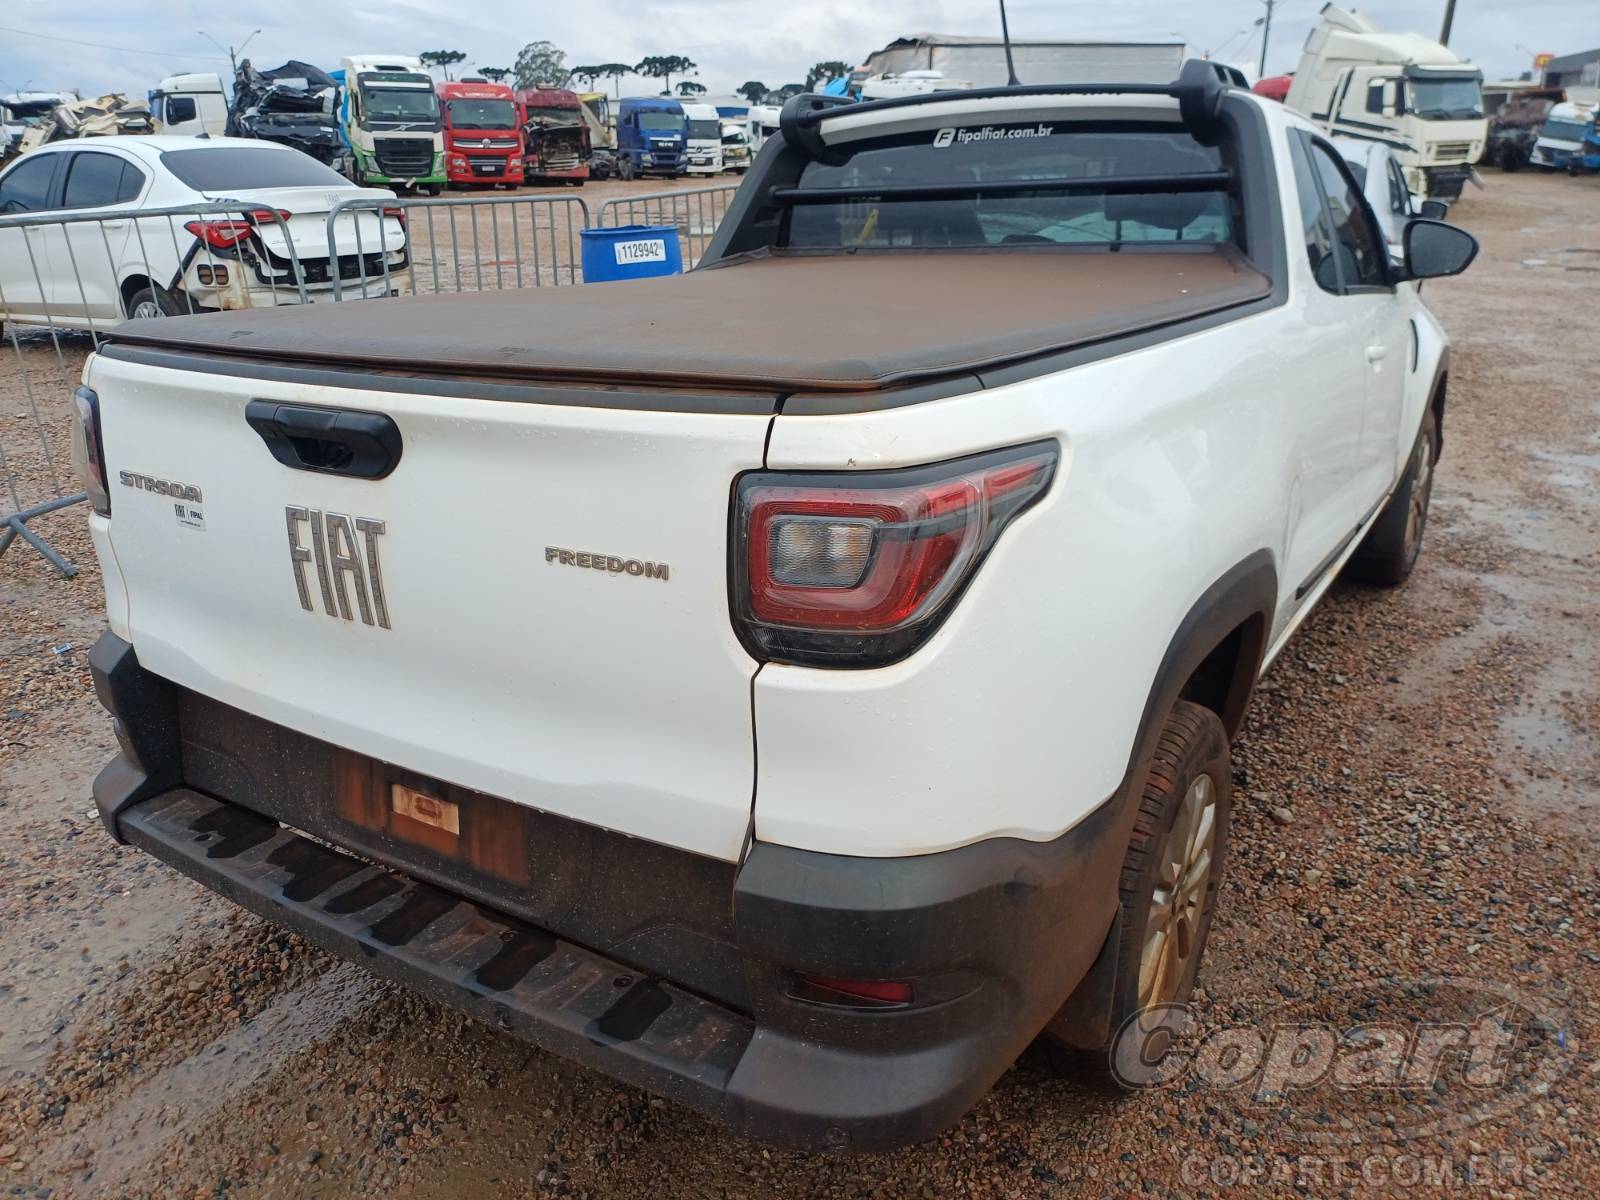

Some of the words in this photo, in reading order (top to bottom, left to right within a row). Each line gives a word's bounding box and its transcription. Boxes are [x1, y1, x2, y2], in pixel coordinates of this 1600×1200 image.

[957, 124, 1053, 144] fipalfiat.com.br
[621, 242, 660, 259] 1129942
[119, 470, 203, 503] STRADA
[284, 504, 392, 630] FIAT
[545, 546, 669, 581] FREEDOM
